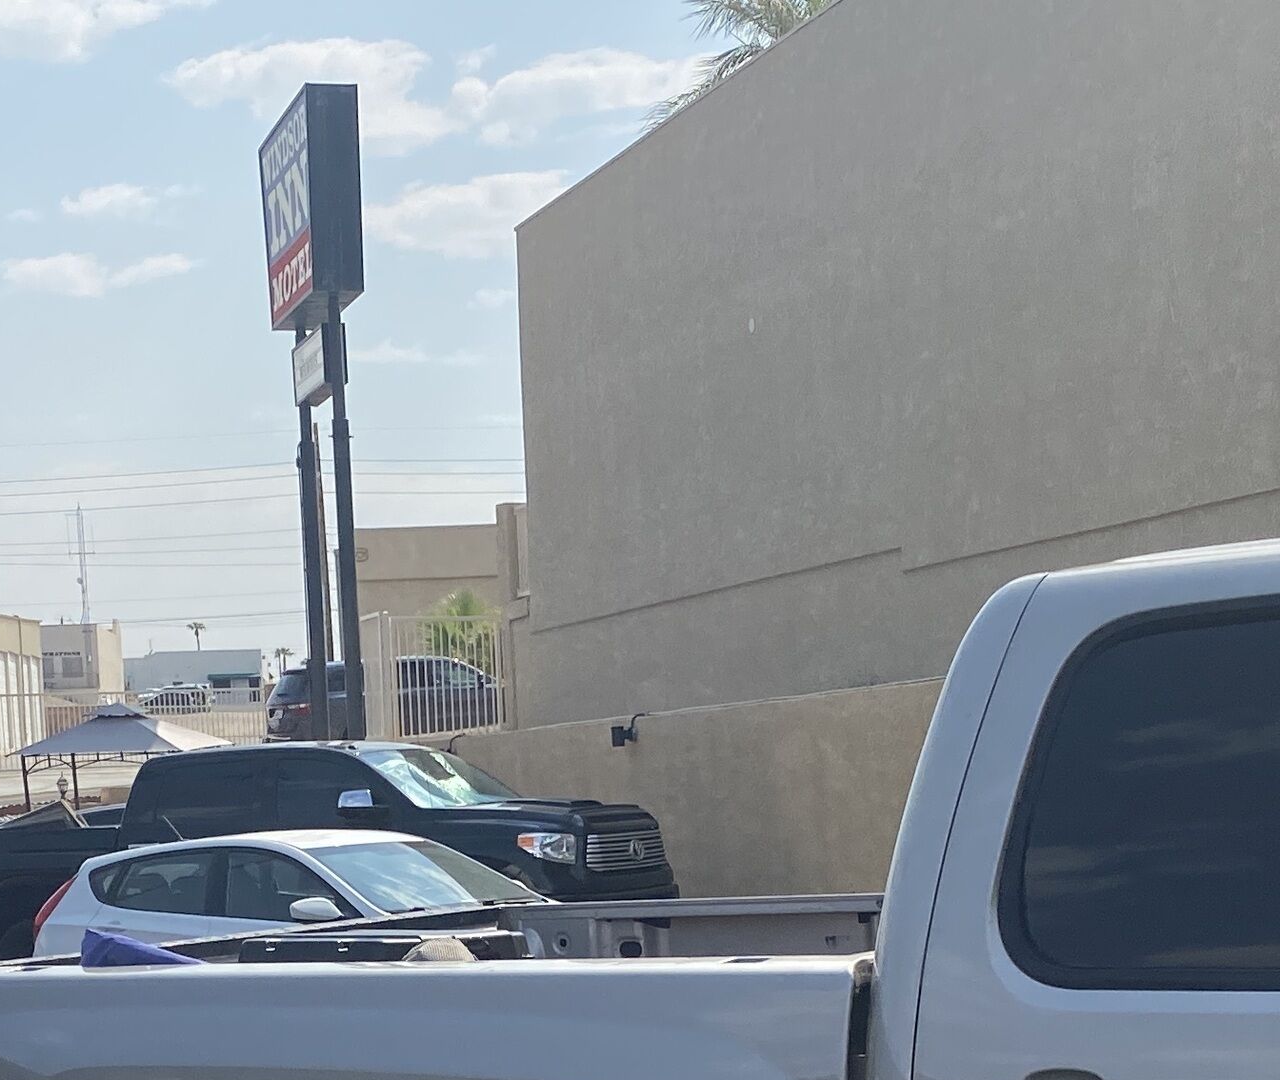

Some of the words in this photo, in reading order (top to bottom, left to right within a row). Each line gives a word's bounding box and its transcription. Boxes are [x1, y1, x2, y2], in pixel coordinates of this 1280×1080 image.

[262, 104, 308, 189] WINDSOR
[267, 148, 311, 257] INN
[272, 241, 313, 312] MOTEL
